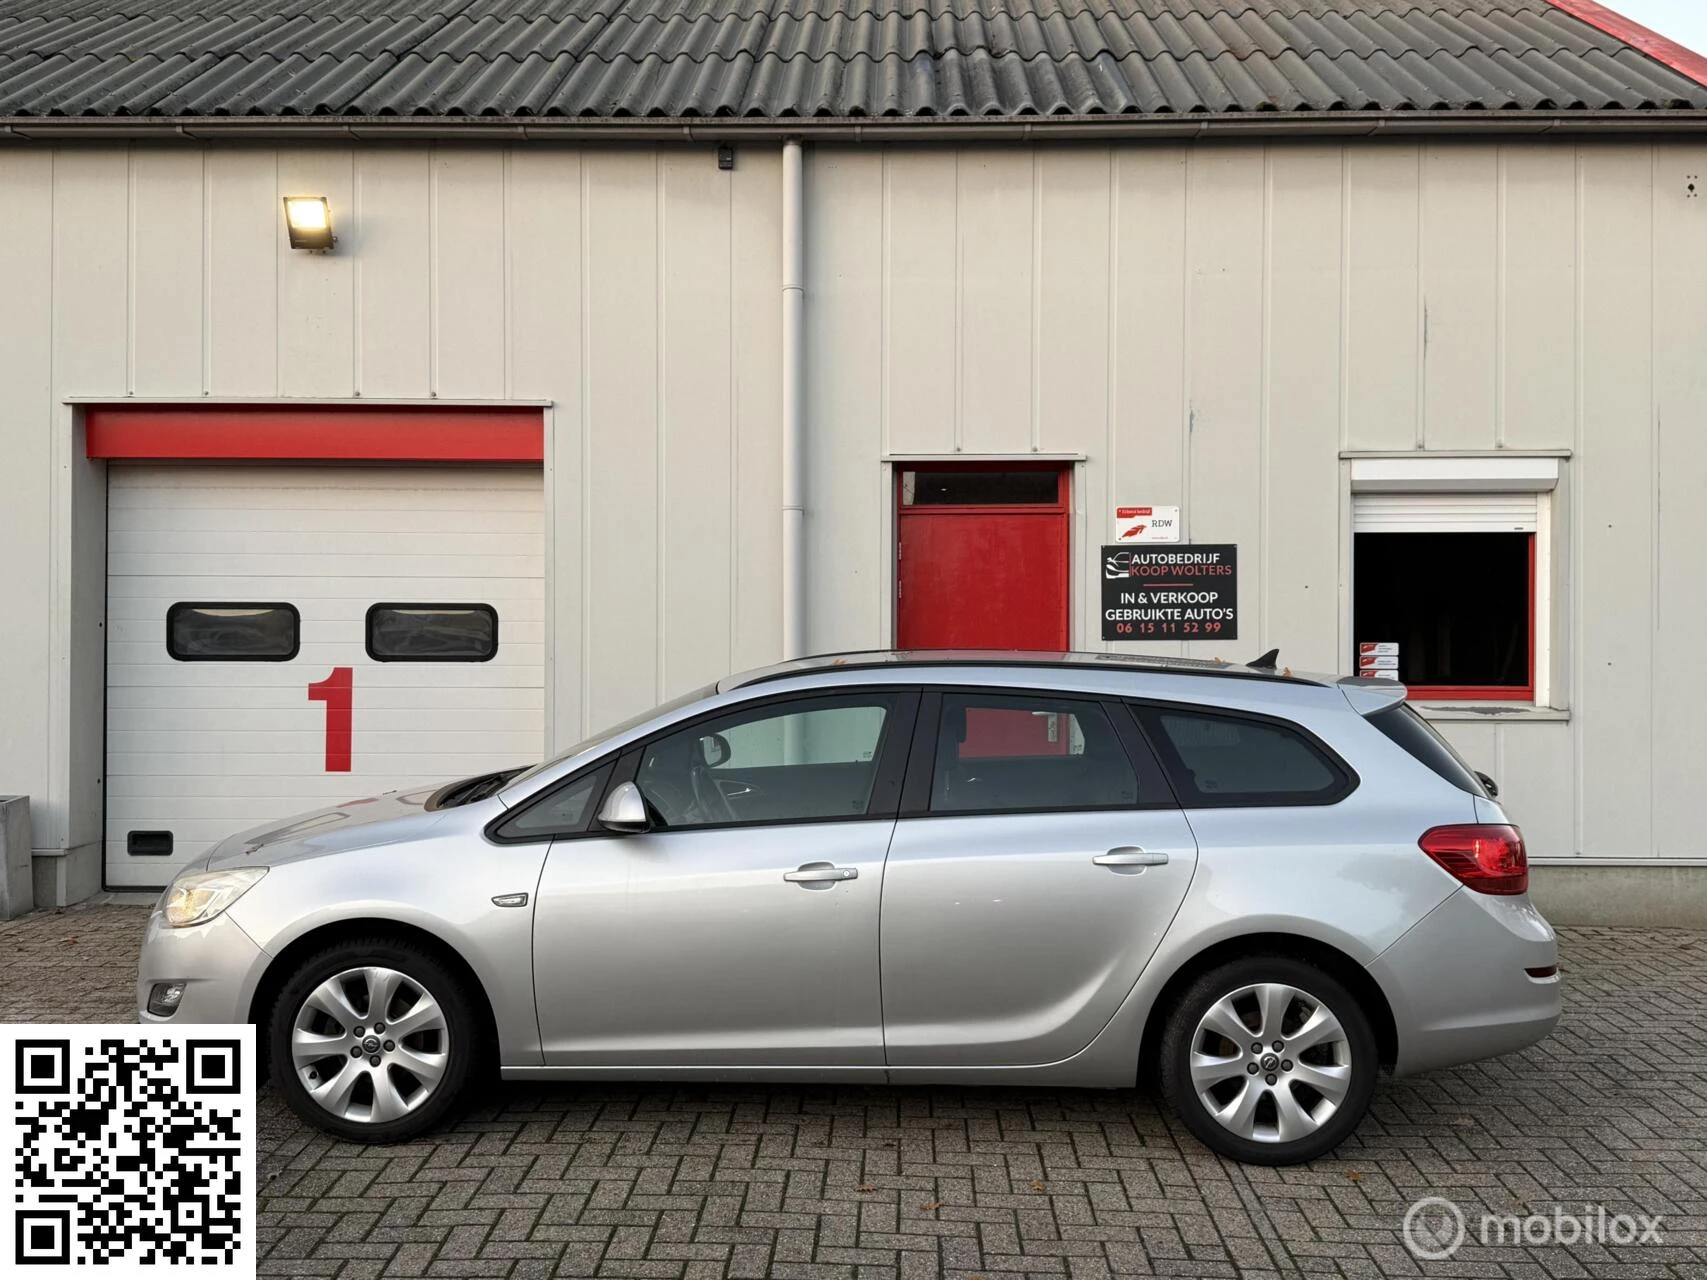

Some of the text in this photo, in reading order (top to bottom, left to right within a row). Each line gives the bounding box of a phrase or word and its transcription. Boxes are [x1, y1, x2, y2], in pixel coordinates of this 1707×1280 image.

[1151, 519, 1173, 528] RDW
[1131, 553, 1221, 564] AUTOBEDRIJF
[1131, 564, 1232, 576] KOOP WOLTERS
[1120, 592, 1218, 604] IN & VERKOOP
[1105, 608, 1234, 620] GEBRUIKTE AUTO'S
[1116, 622, 1222, 633] 06 15 11 52 99
[307, 667, 354, 772] 1
